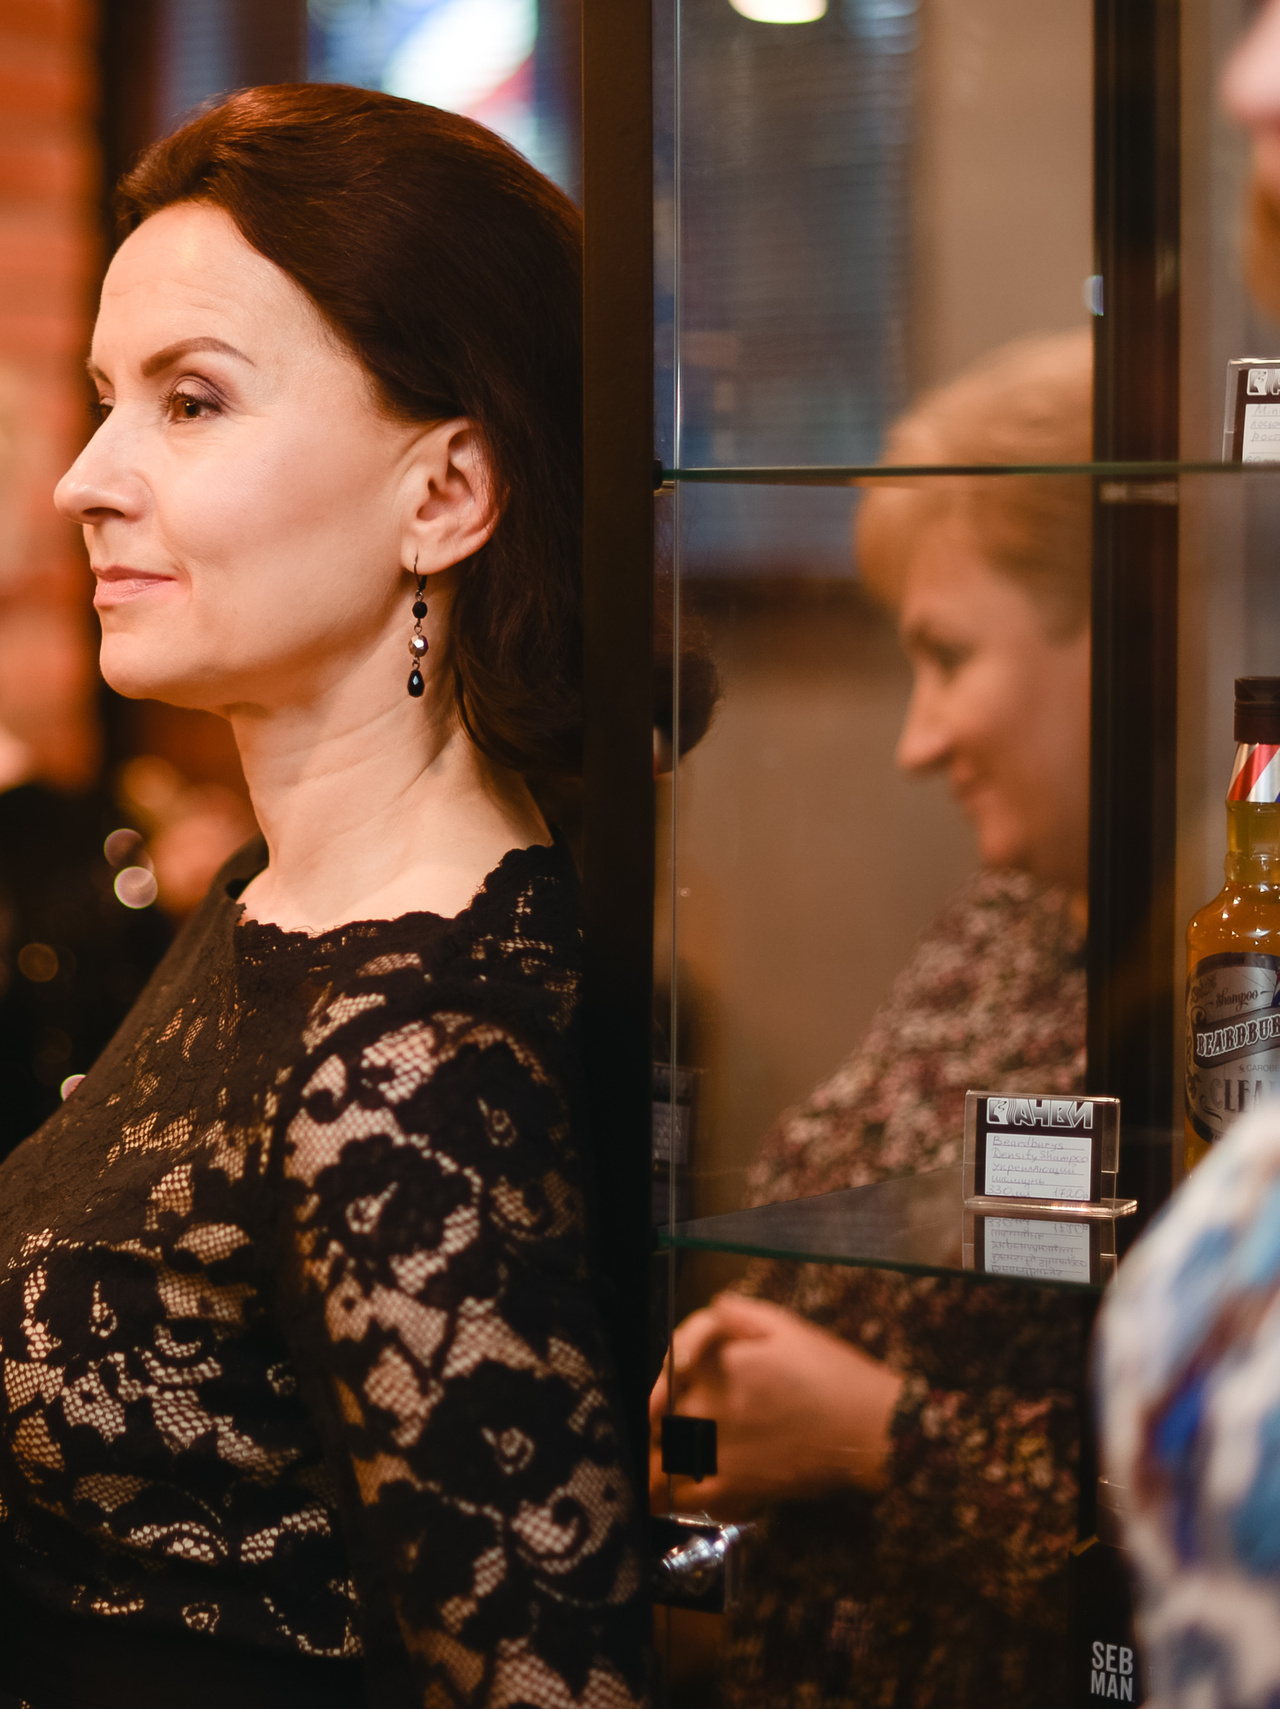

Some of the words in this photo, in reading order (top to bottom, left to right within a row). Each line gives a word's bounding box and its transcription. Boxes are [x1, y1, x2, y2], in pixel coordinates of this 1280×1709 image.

[1253, 404, 1280, 416] Min
[1092, 1641, 1133, 1675] SEB
[1091, 1670, 1133, 1702] MAN
